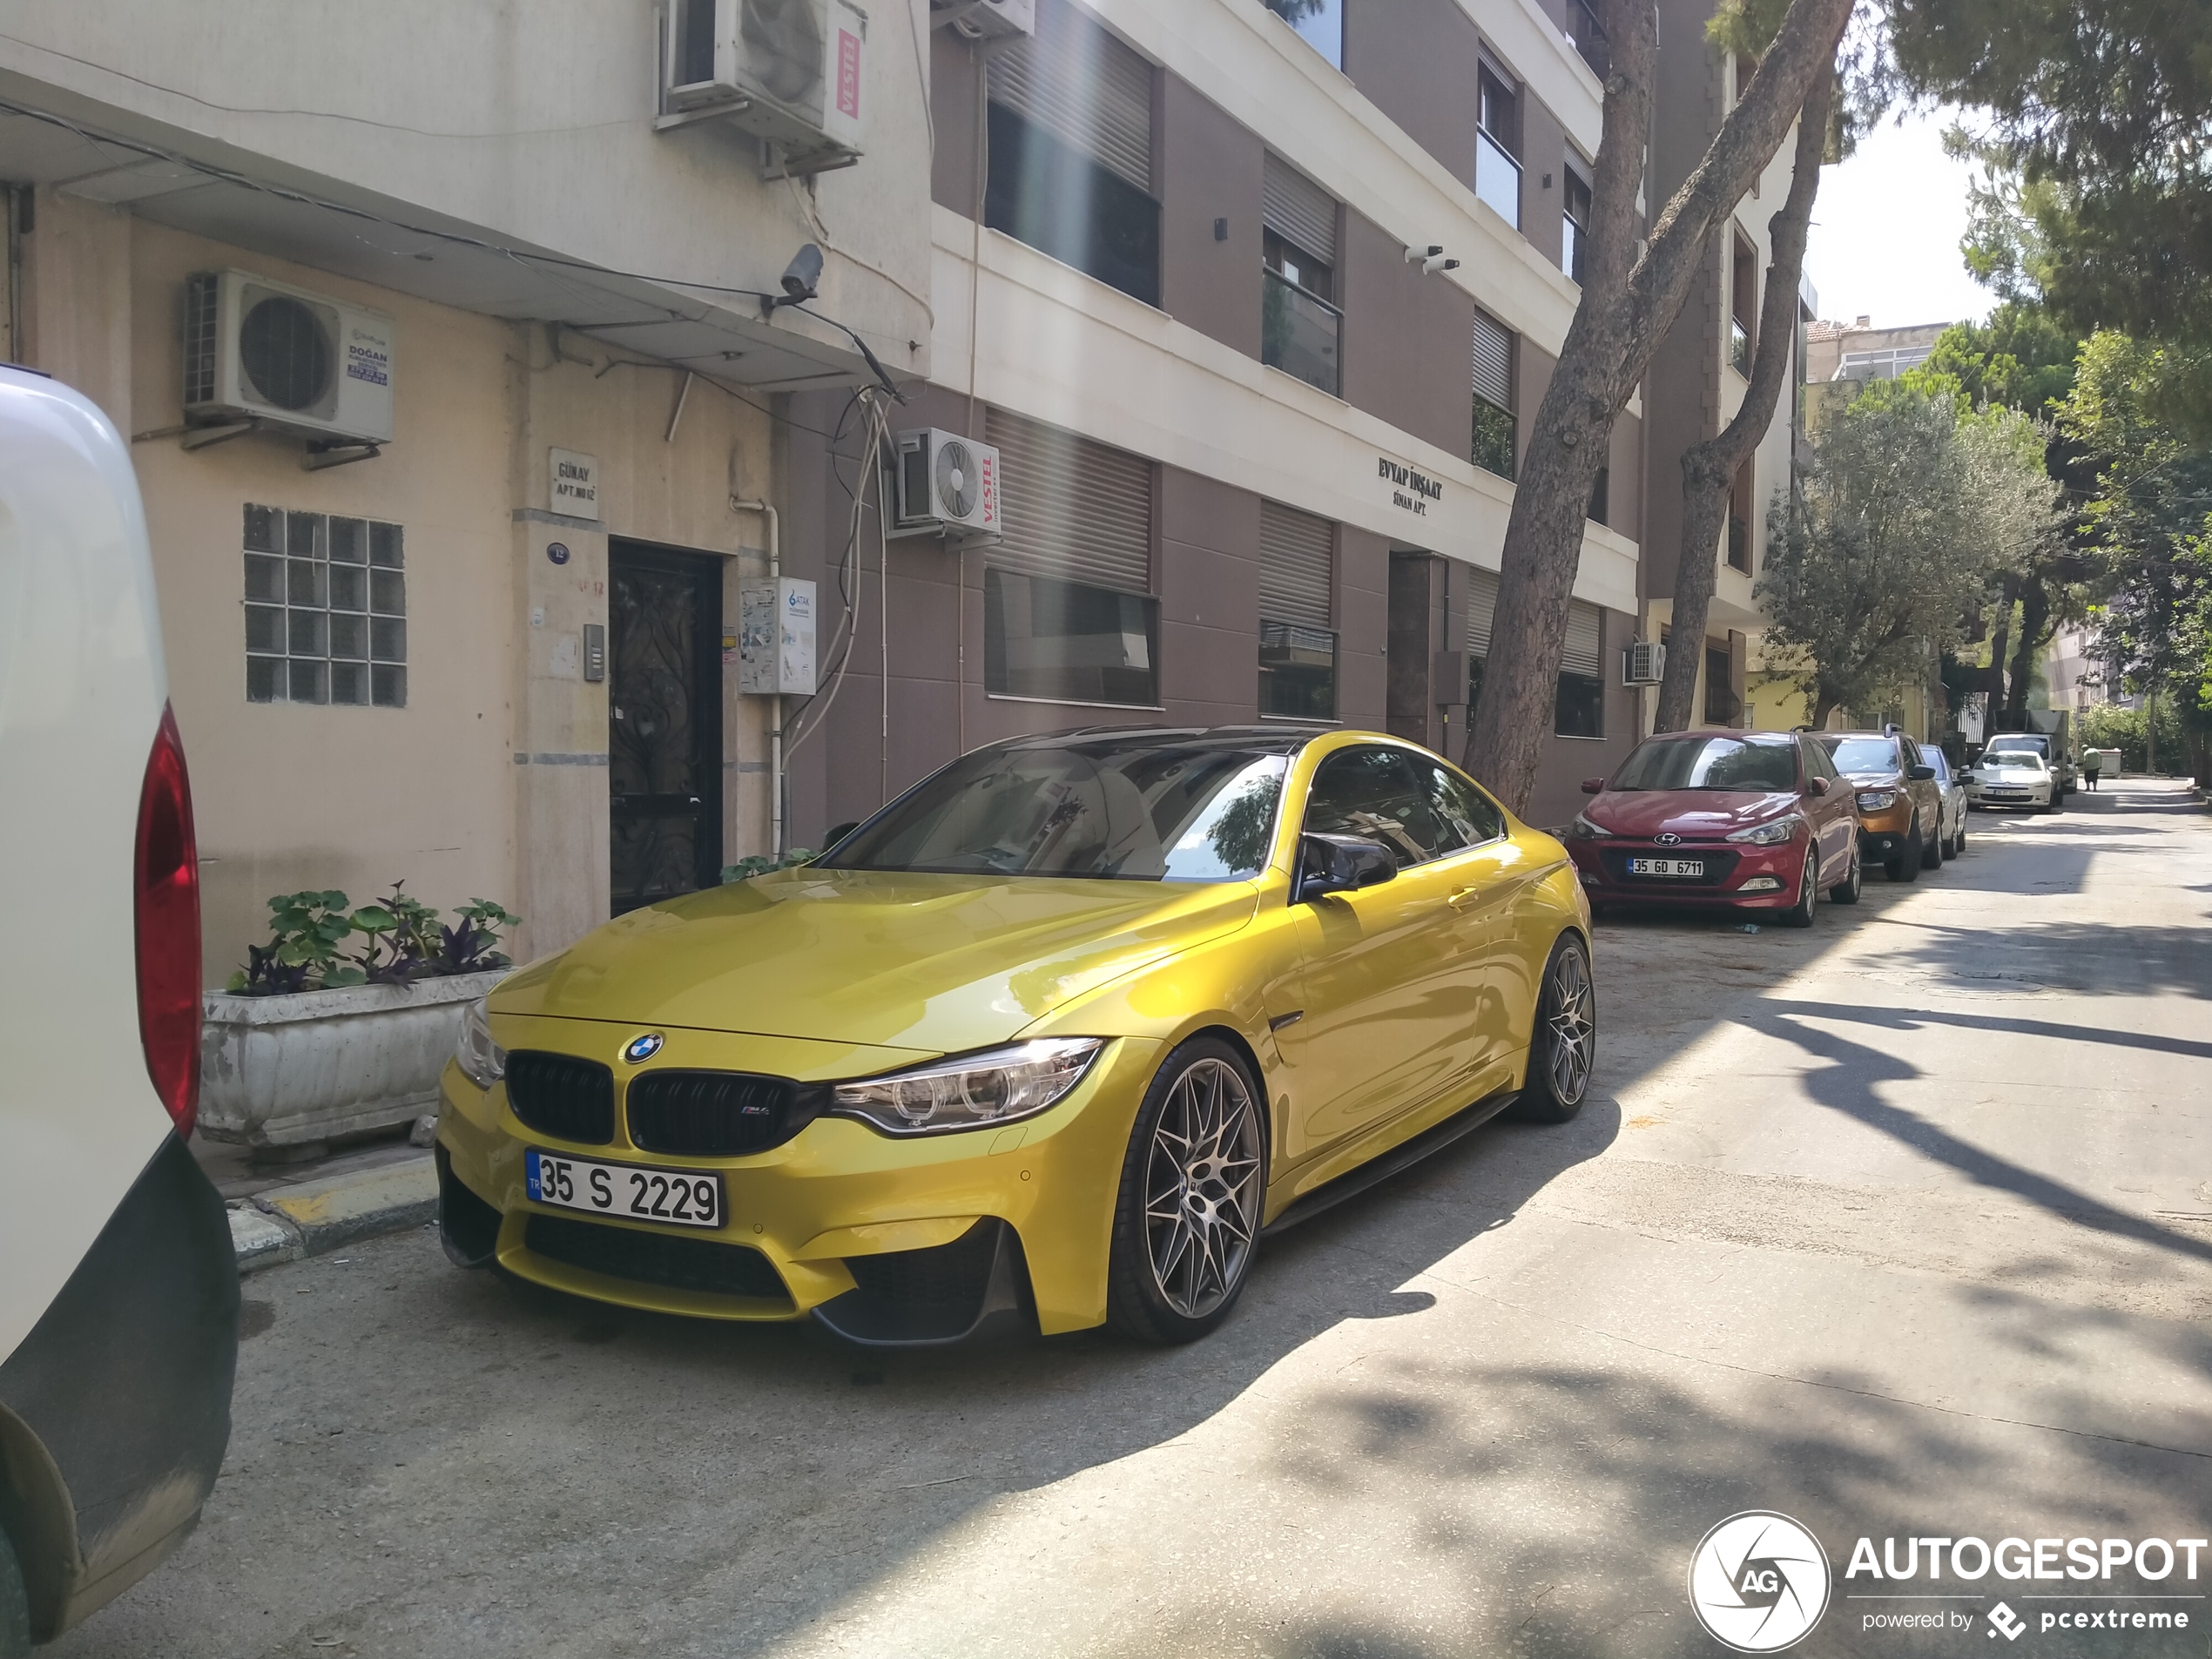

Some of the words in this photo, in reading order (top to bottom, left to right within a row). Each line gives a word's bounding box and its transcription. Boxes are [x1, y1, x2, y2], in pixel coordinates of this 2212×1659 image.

[842, 37, 855, 111] VESTEL
[349, 345, 388, 362] DOĞAN
[559, 462, 590, 482] GÜNAY
[1379, 457, 1408, 486] EVYAP
[1410, 465, 1442, 501] İNŞAAT
[983, 455, 993, 523] VESTEL
[1393, 489, 1413, 511] SİNAN
[556, 549, 564, 558] 12
[796, 596, 810, 606] ATAK
[1635, 860, 1648, 872] 35
[1655, 861, 1668, 873] GD
[1677, 862, 1702, 874] 6711
[529, 1178, 540, 1190] TR
[541, 1159, 573, 1202] 35
[590, 1169, 612, 1208] S
[630, 1173, 715, 1221] 2229
